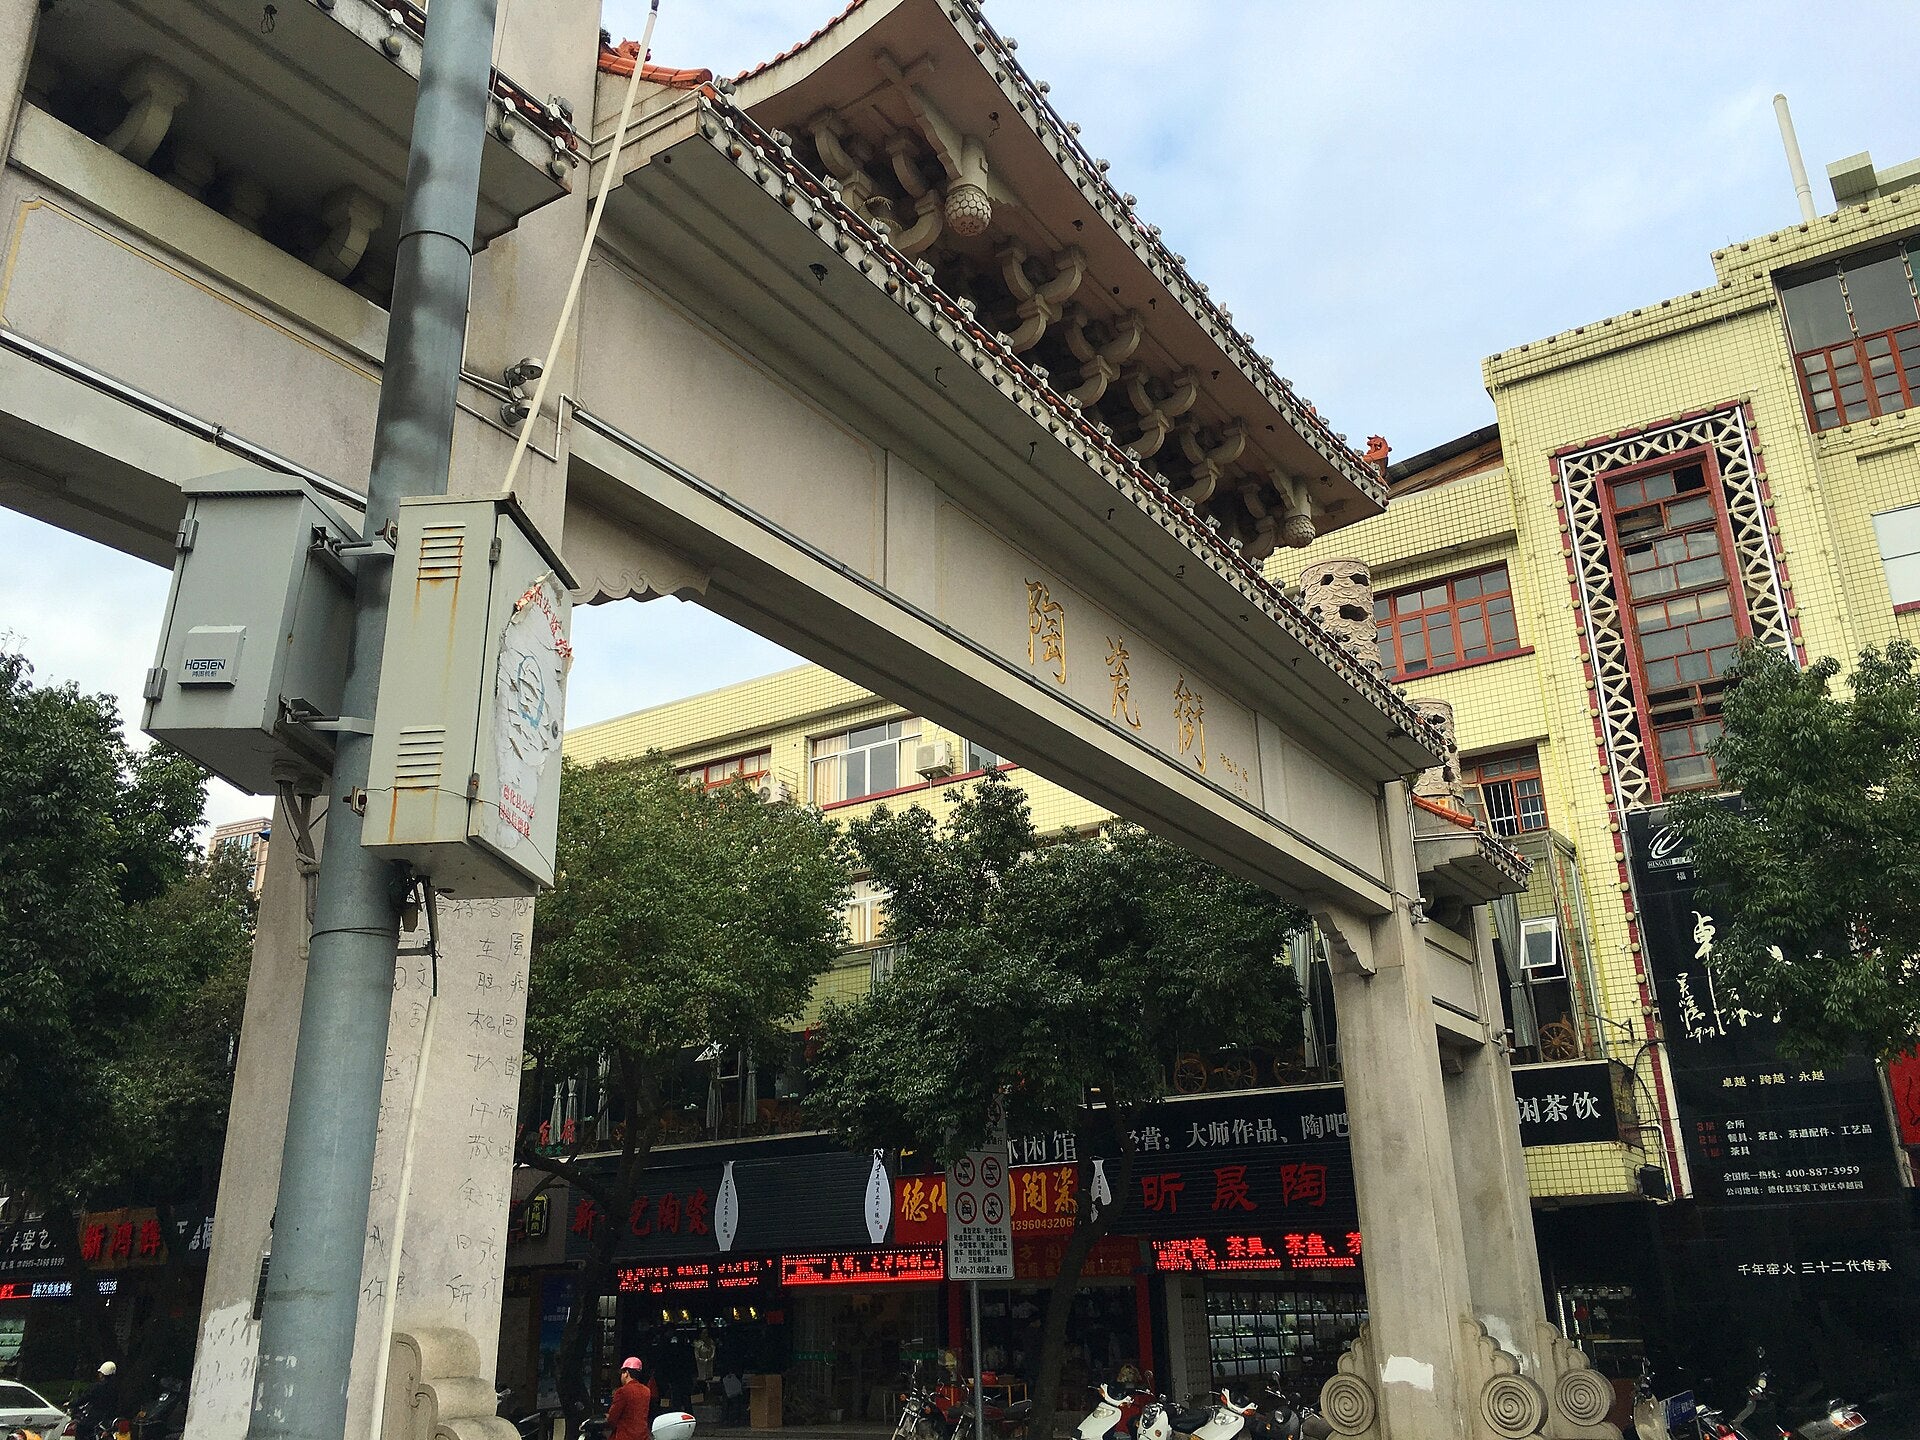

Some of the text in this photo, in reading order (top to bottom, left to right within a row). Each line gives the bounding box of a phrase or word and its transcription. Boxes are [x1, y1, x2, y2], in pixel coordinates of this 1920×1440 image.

[1737, 1258, 1893, 1277] 千年窑火 三十二代传承
